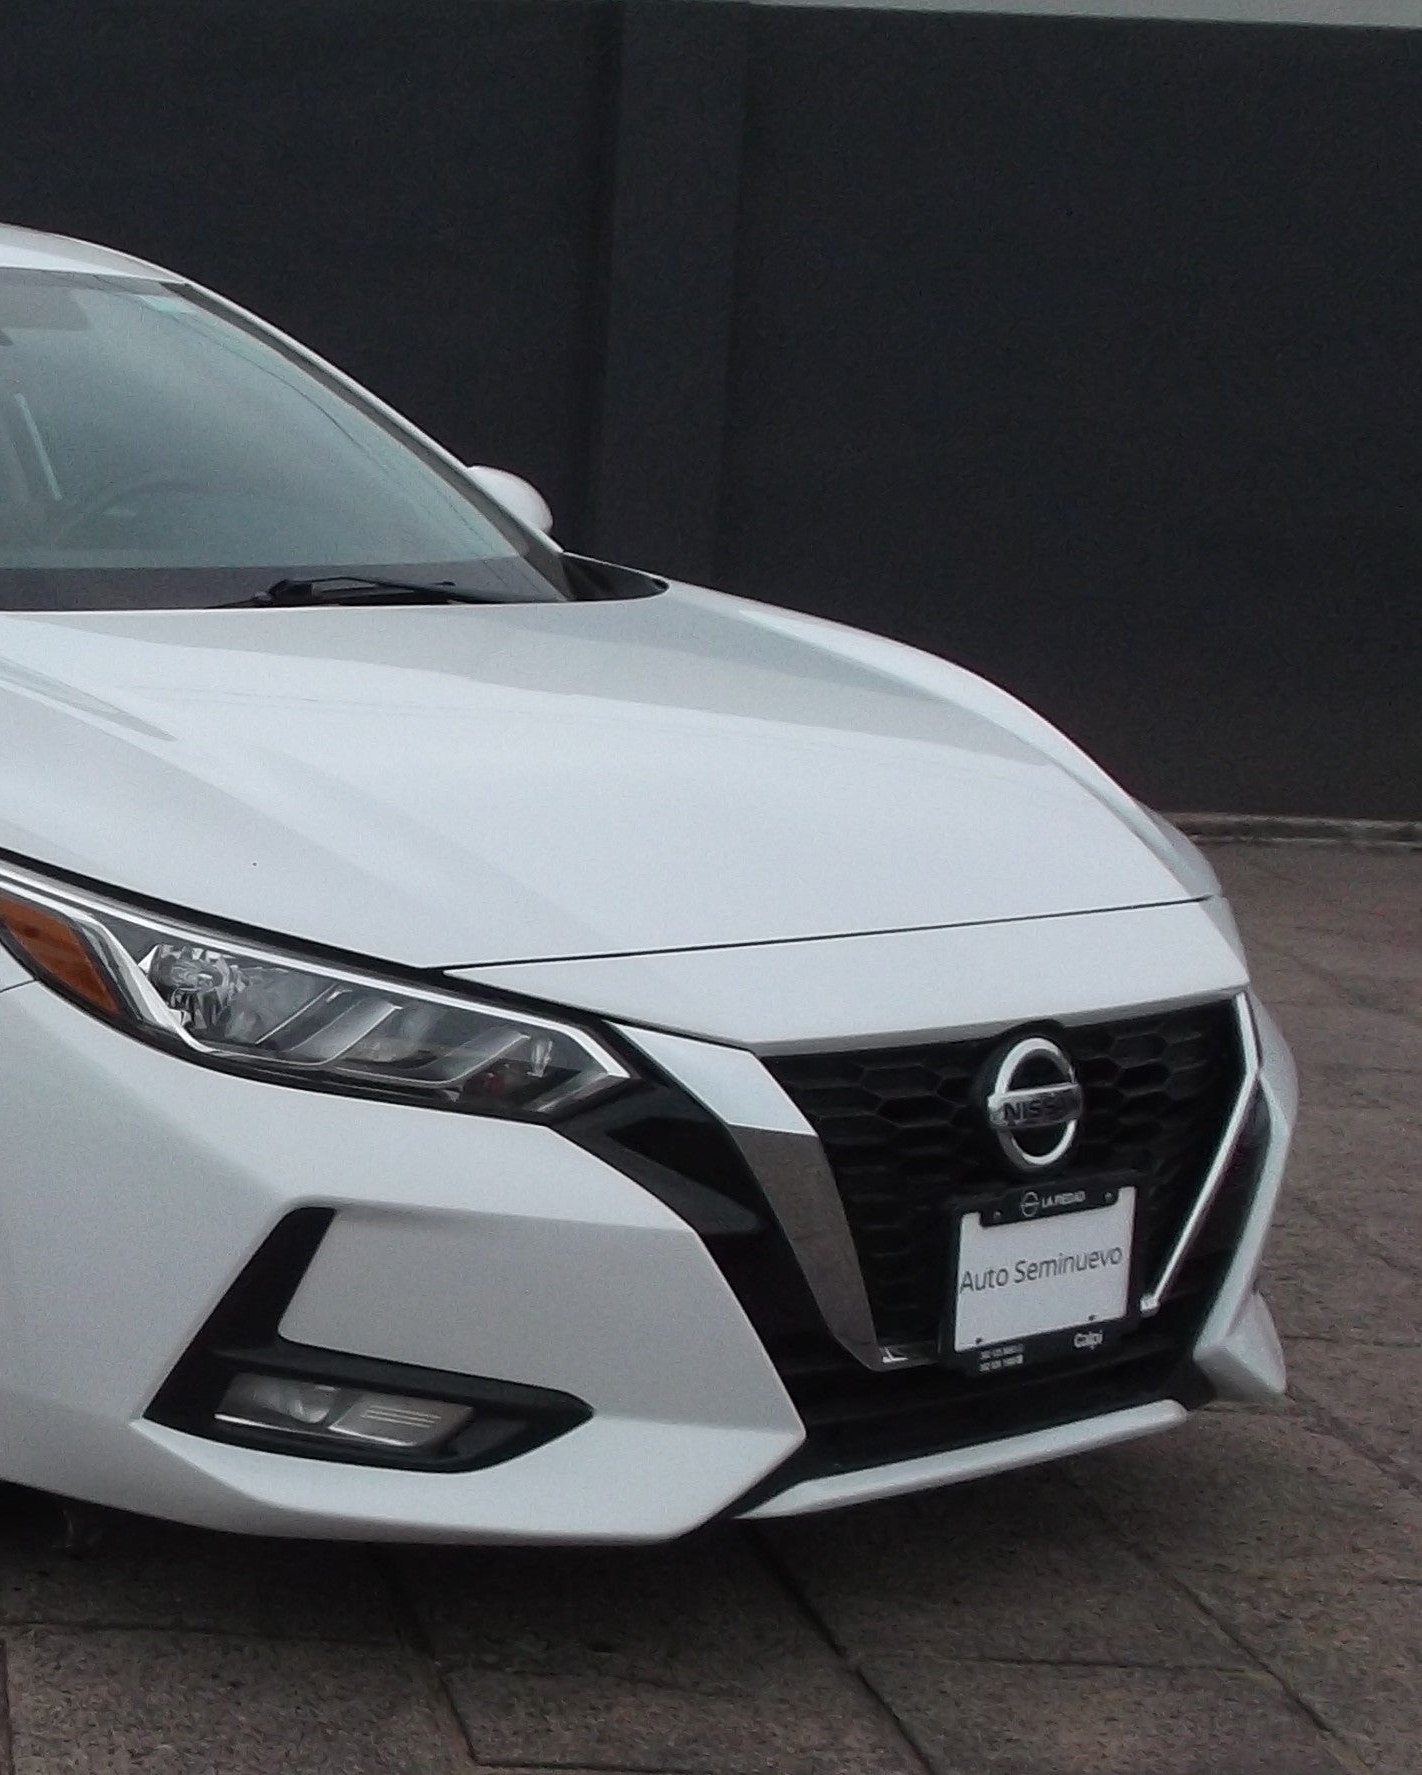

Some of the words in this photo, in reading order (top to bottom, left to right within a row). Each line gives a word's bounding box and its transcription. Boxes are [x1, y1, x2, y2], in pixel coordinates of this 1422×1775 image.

[1002, 1096, 1071, 1122] NISS
[959, 1268, 1009, 1293] Auto
[1013, 1247, 1123, 1284] Seminuevo
